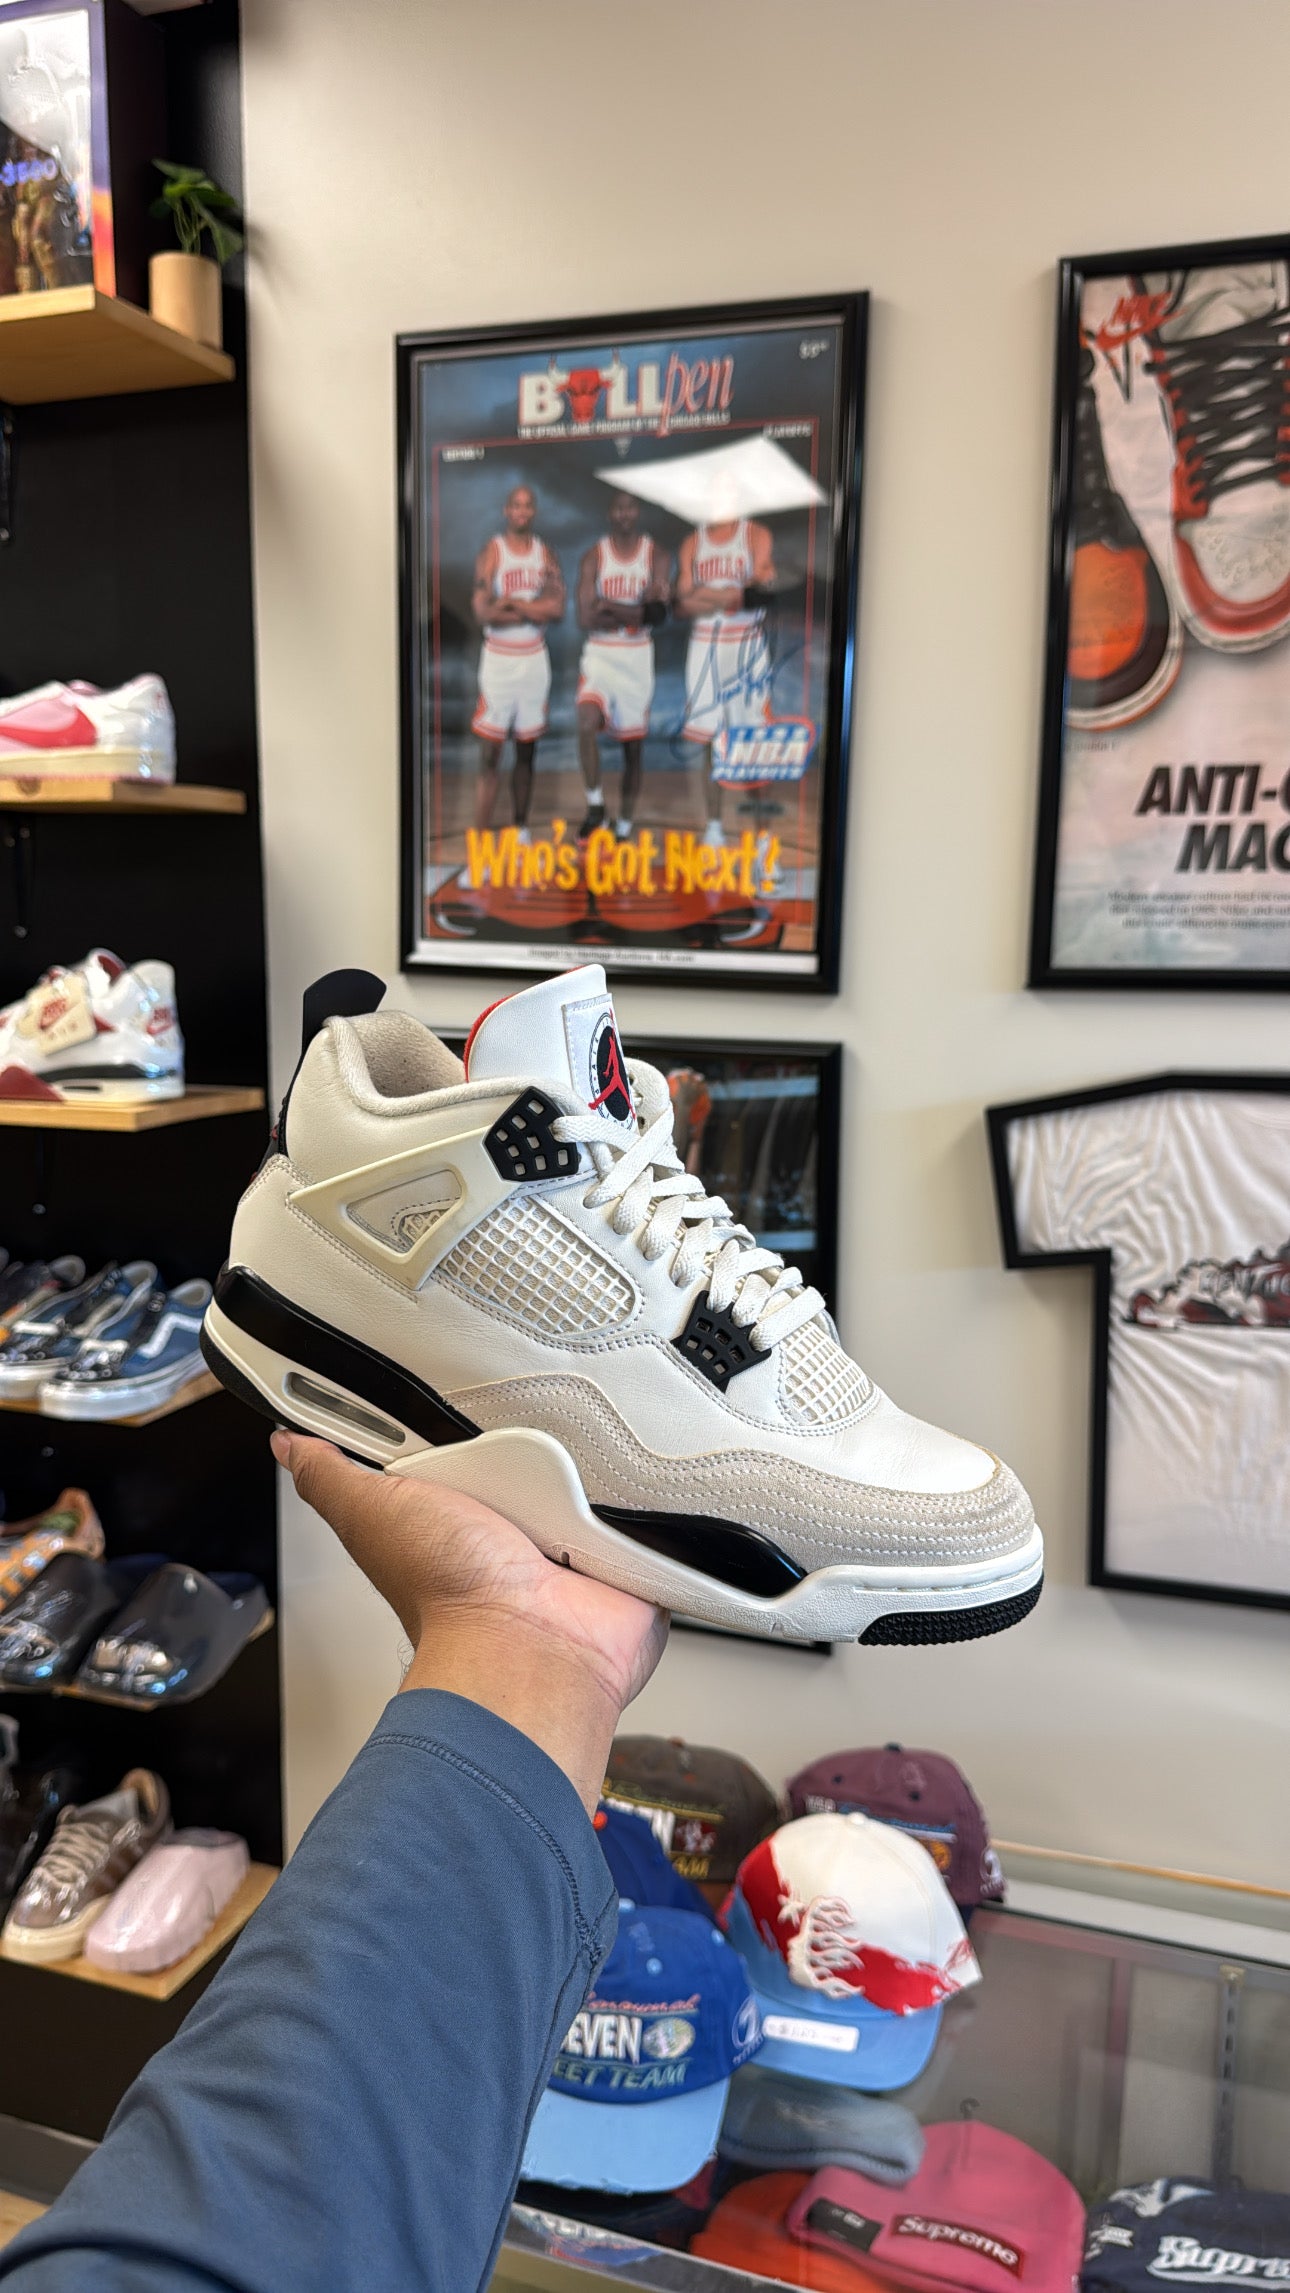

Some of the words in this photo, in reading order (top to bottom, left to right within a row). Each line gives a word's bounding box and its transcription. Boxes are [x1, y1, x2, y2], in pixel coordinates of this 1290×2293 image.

[466, 818, 579, 891] Who's
[585, 827, 658, 896] Got
[560, 2011, 643, 2064] EVEN
[898, 2215, 1019, 2266] Supreme
